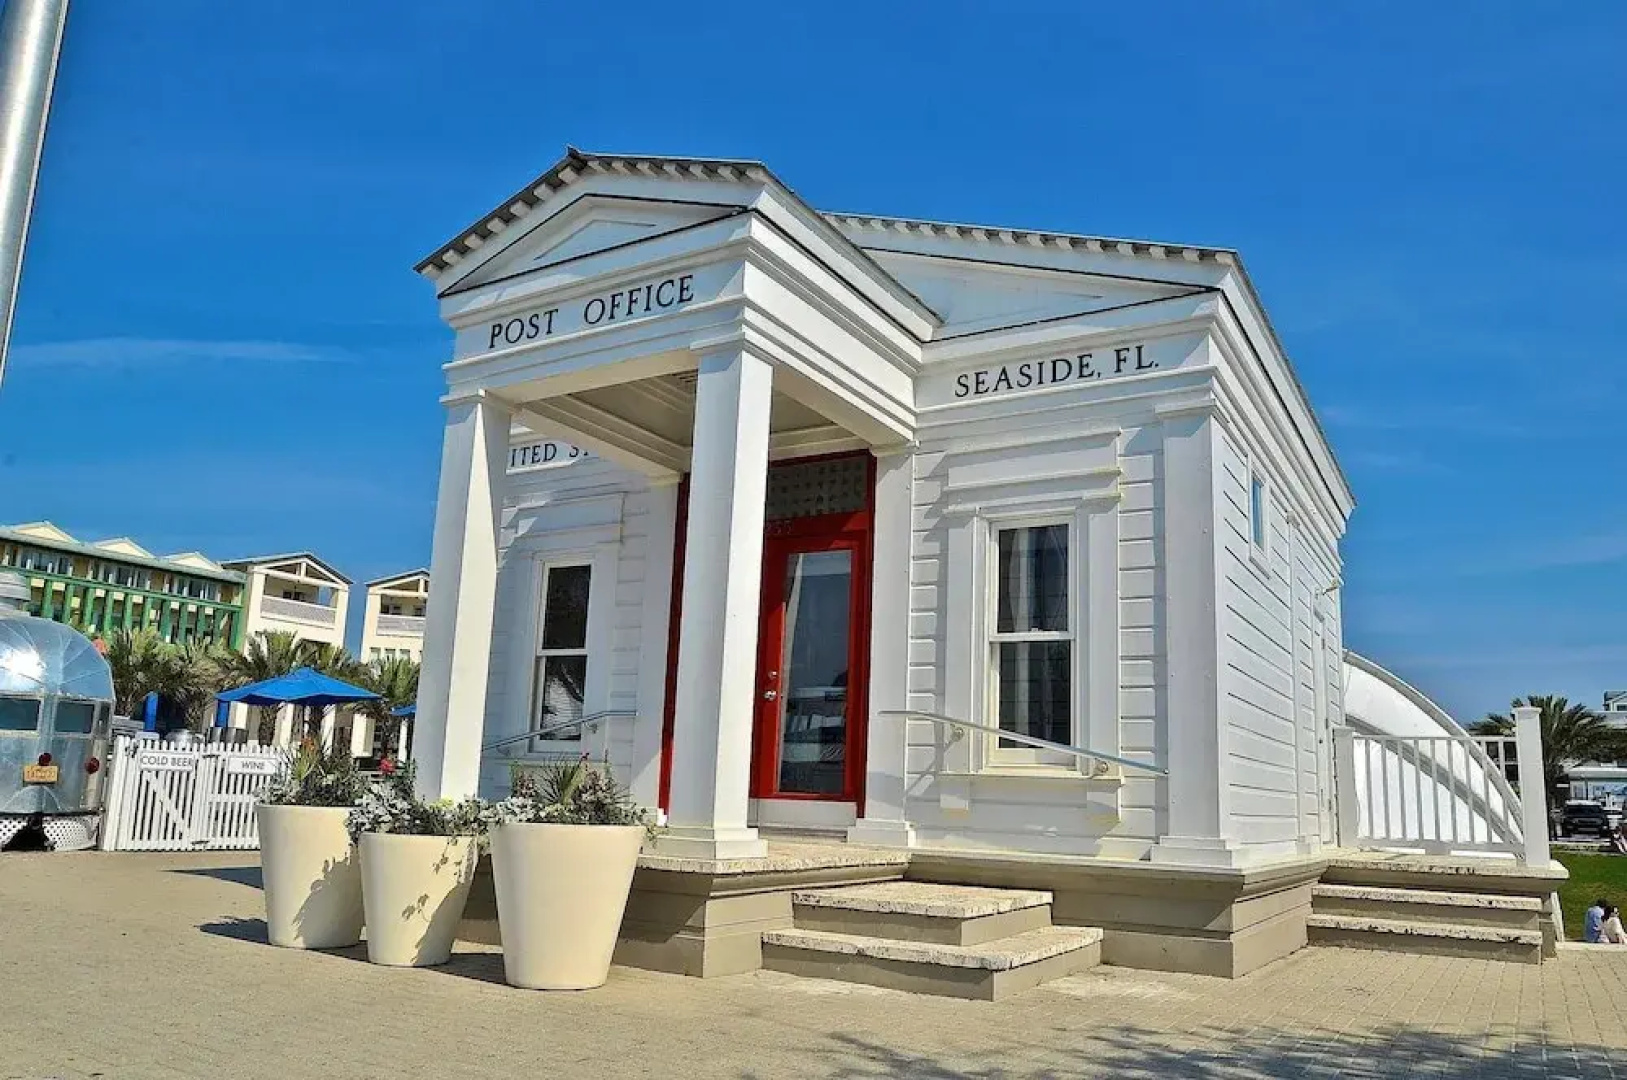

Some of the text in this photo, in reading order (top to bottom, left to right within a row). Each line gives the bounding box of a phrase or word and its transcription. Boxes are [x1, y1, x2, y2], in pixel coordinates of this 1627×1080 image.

[488, 274, 694, 349] POST OFFICE
[954, 344, 1159, 398] SEASIDE, FL.
[510, 443, 557, 467] ITED
[140, 756, 168, 765] COLD
[241, 760, 265, 770] WINE
